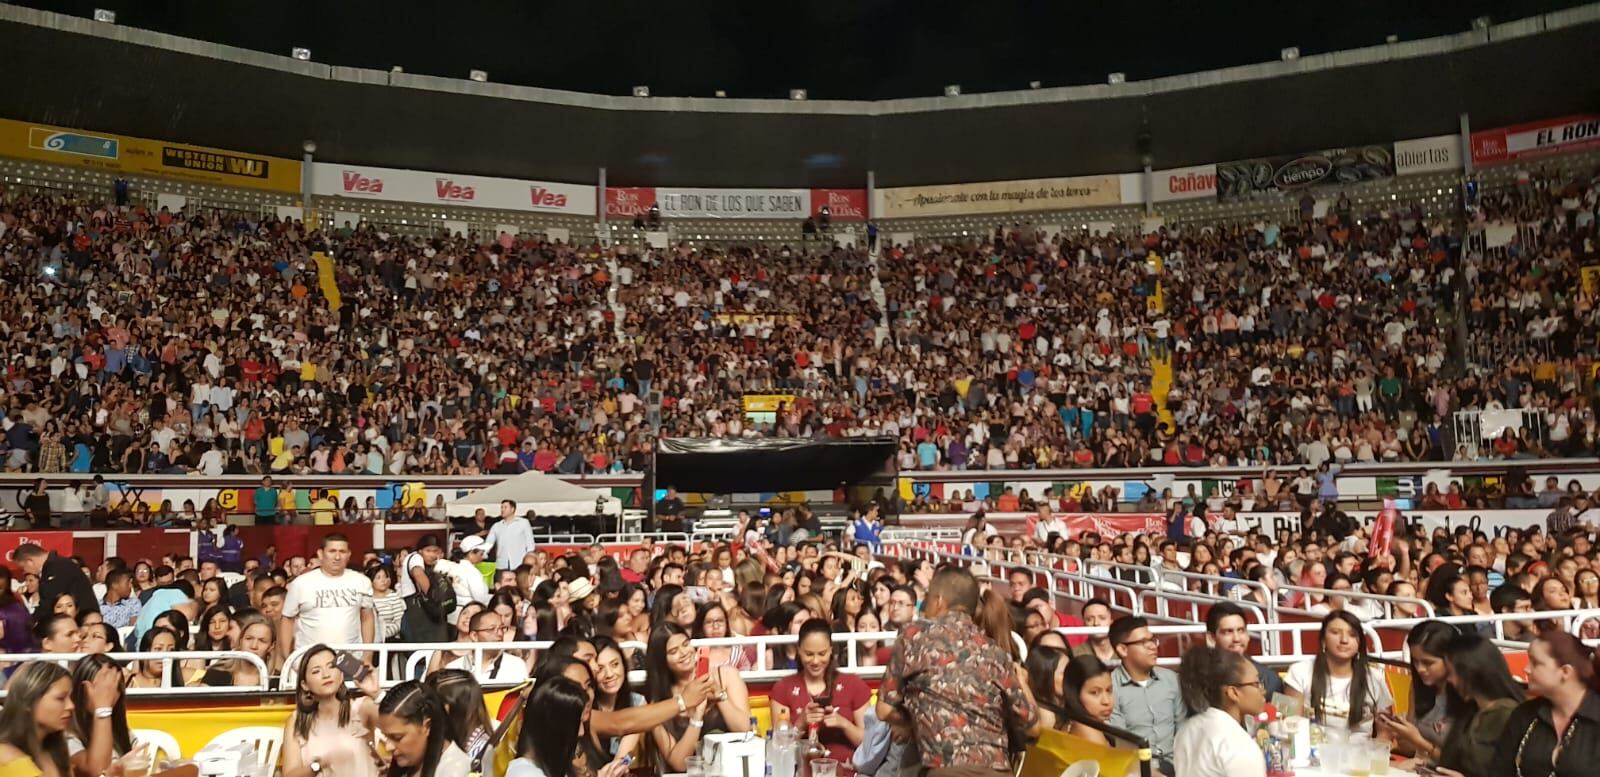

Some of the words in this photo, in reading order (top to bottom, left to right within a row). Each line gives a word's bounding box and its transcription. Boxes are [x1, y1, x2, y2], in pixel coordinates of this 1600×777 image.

[1536, 129, 1556, 147] EL
[1562, 121, 1599, 141] RON
[165, 148, 224, 164] WESTERN
[184, 159, 224, 172] UNION
[1396, 147, 1449, 169] abiertas
[229, 157, 264, 177] WU
[1282, 167, 1325, 185] tiempo
[342, 172, 384, 193] Vea
[435, 179, 476, 200] Vea
[530, 187, 568, 207] Vea
[665, 194, 677, 211] EL
[680, 194, 702, 211] RON
[706, 194, 719, 211] DE
[722, 195, 742, 212] LOS
[745, 195, 765, 212] QUE
[768, 195, 802, 212] SABEN
[970, 191, 987, 203] con
[1035, 185, 1049, 200] de
